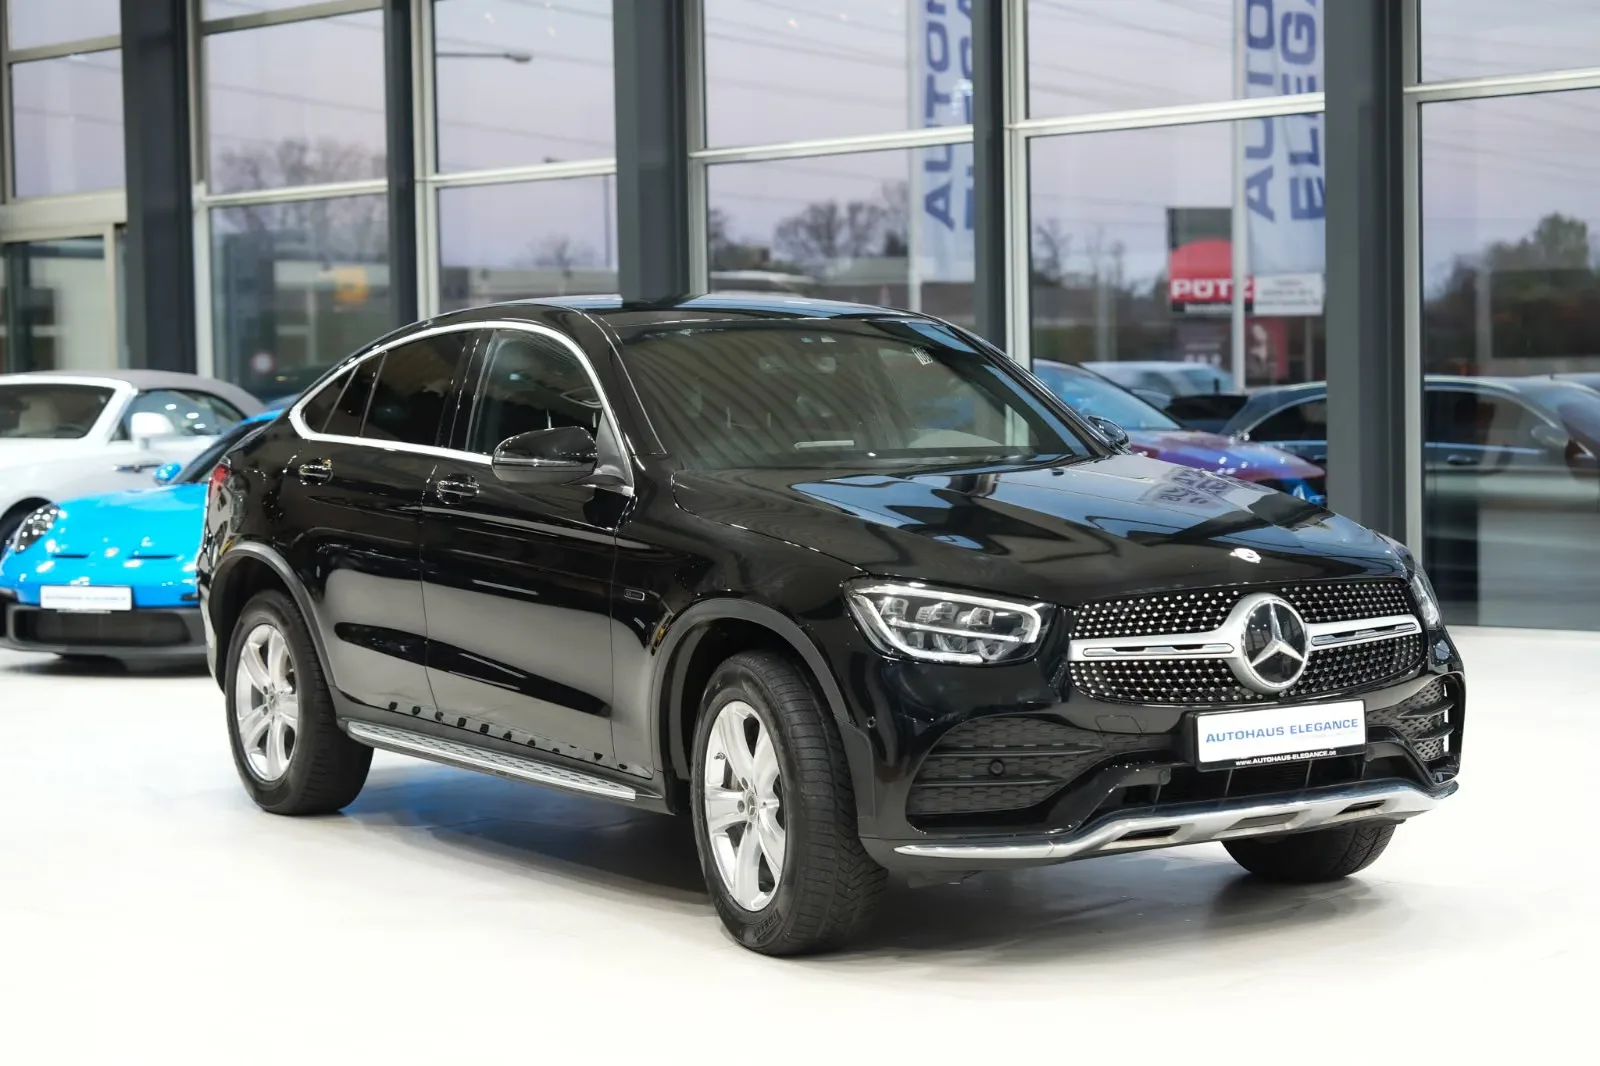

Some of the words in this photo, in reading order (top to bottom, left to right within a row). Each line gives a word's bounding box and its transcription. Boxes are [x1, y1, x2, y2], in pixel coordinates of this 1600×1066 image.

[925, 0, 955, 232] AUTO
[1280, 0, 1326, 220] ELEG
[1205, 726, 1285, 743] AUTOHAUS
[1290, 718, 1359, 735] ELEGANCE
